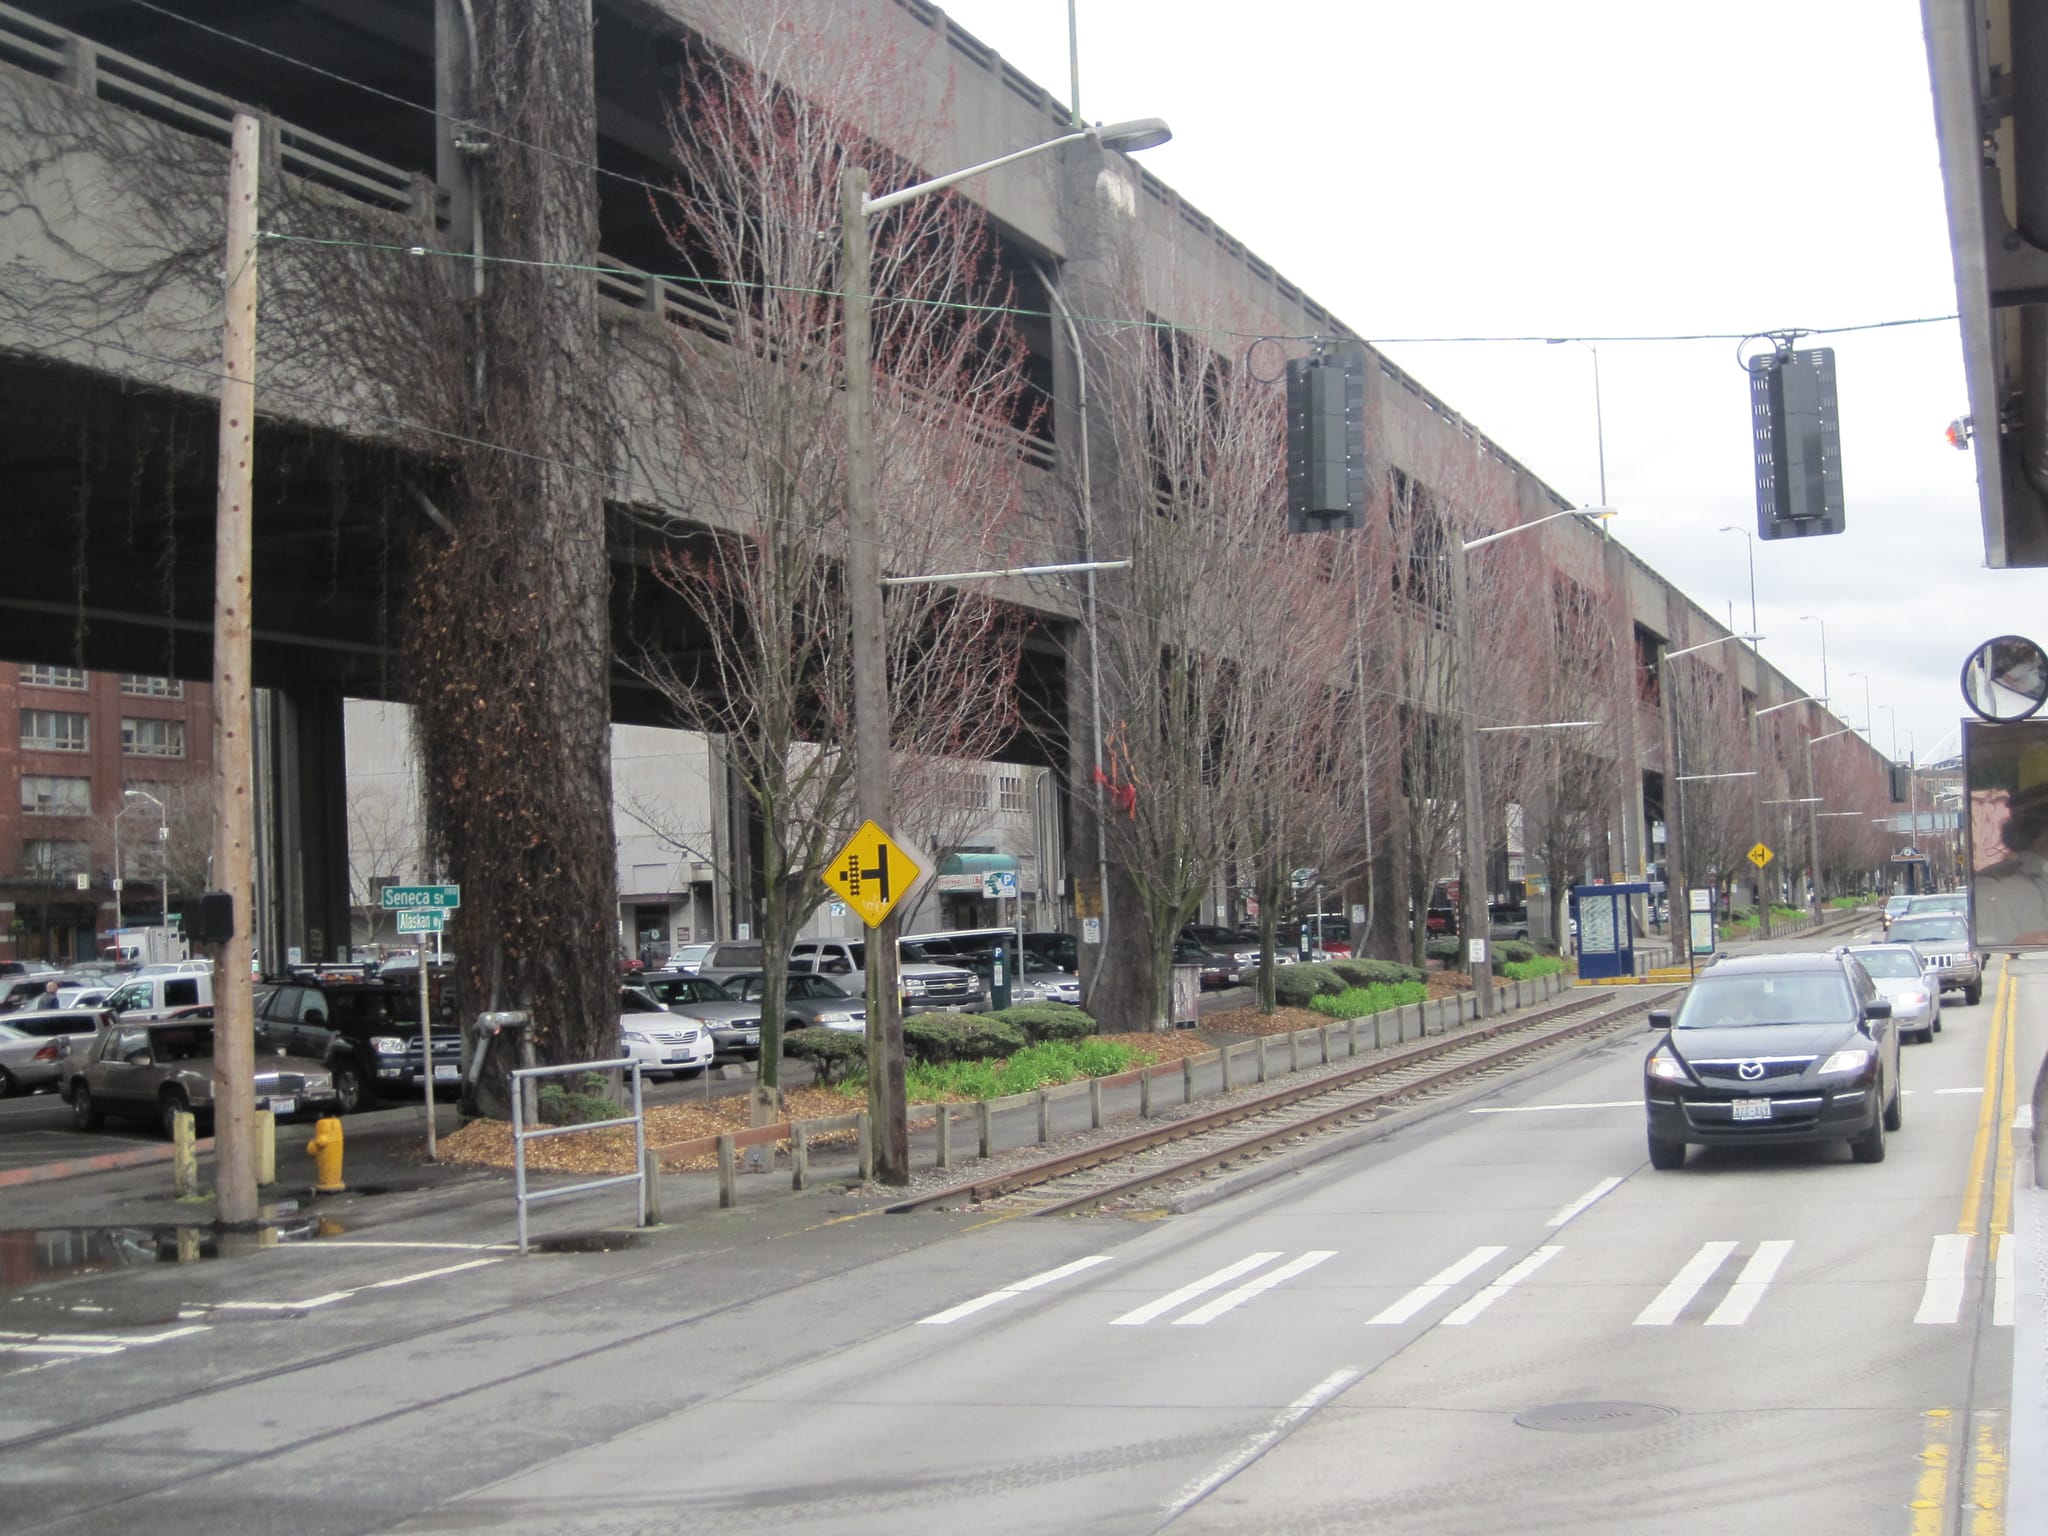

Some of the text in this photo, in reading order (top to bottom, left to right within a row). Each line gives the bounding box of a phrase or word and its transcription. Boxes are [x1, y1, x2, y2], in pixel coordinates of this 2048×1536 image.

[385, 889, 430, 906] Seneca
[433, 891, 444, 905] St
[400, 913, 431, 929] Alaskan
